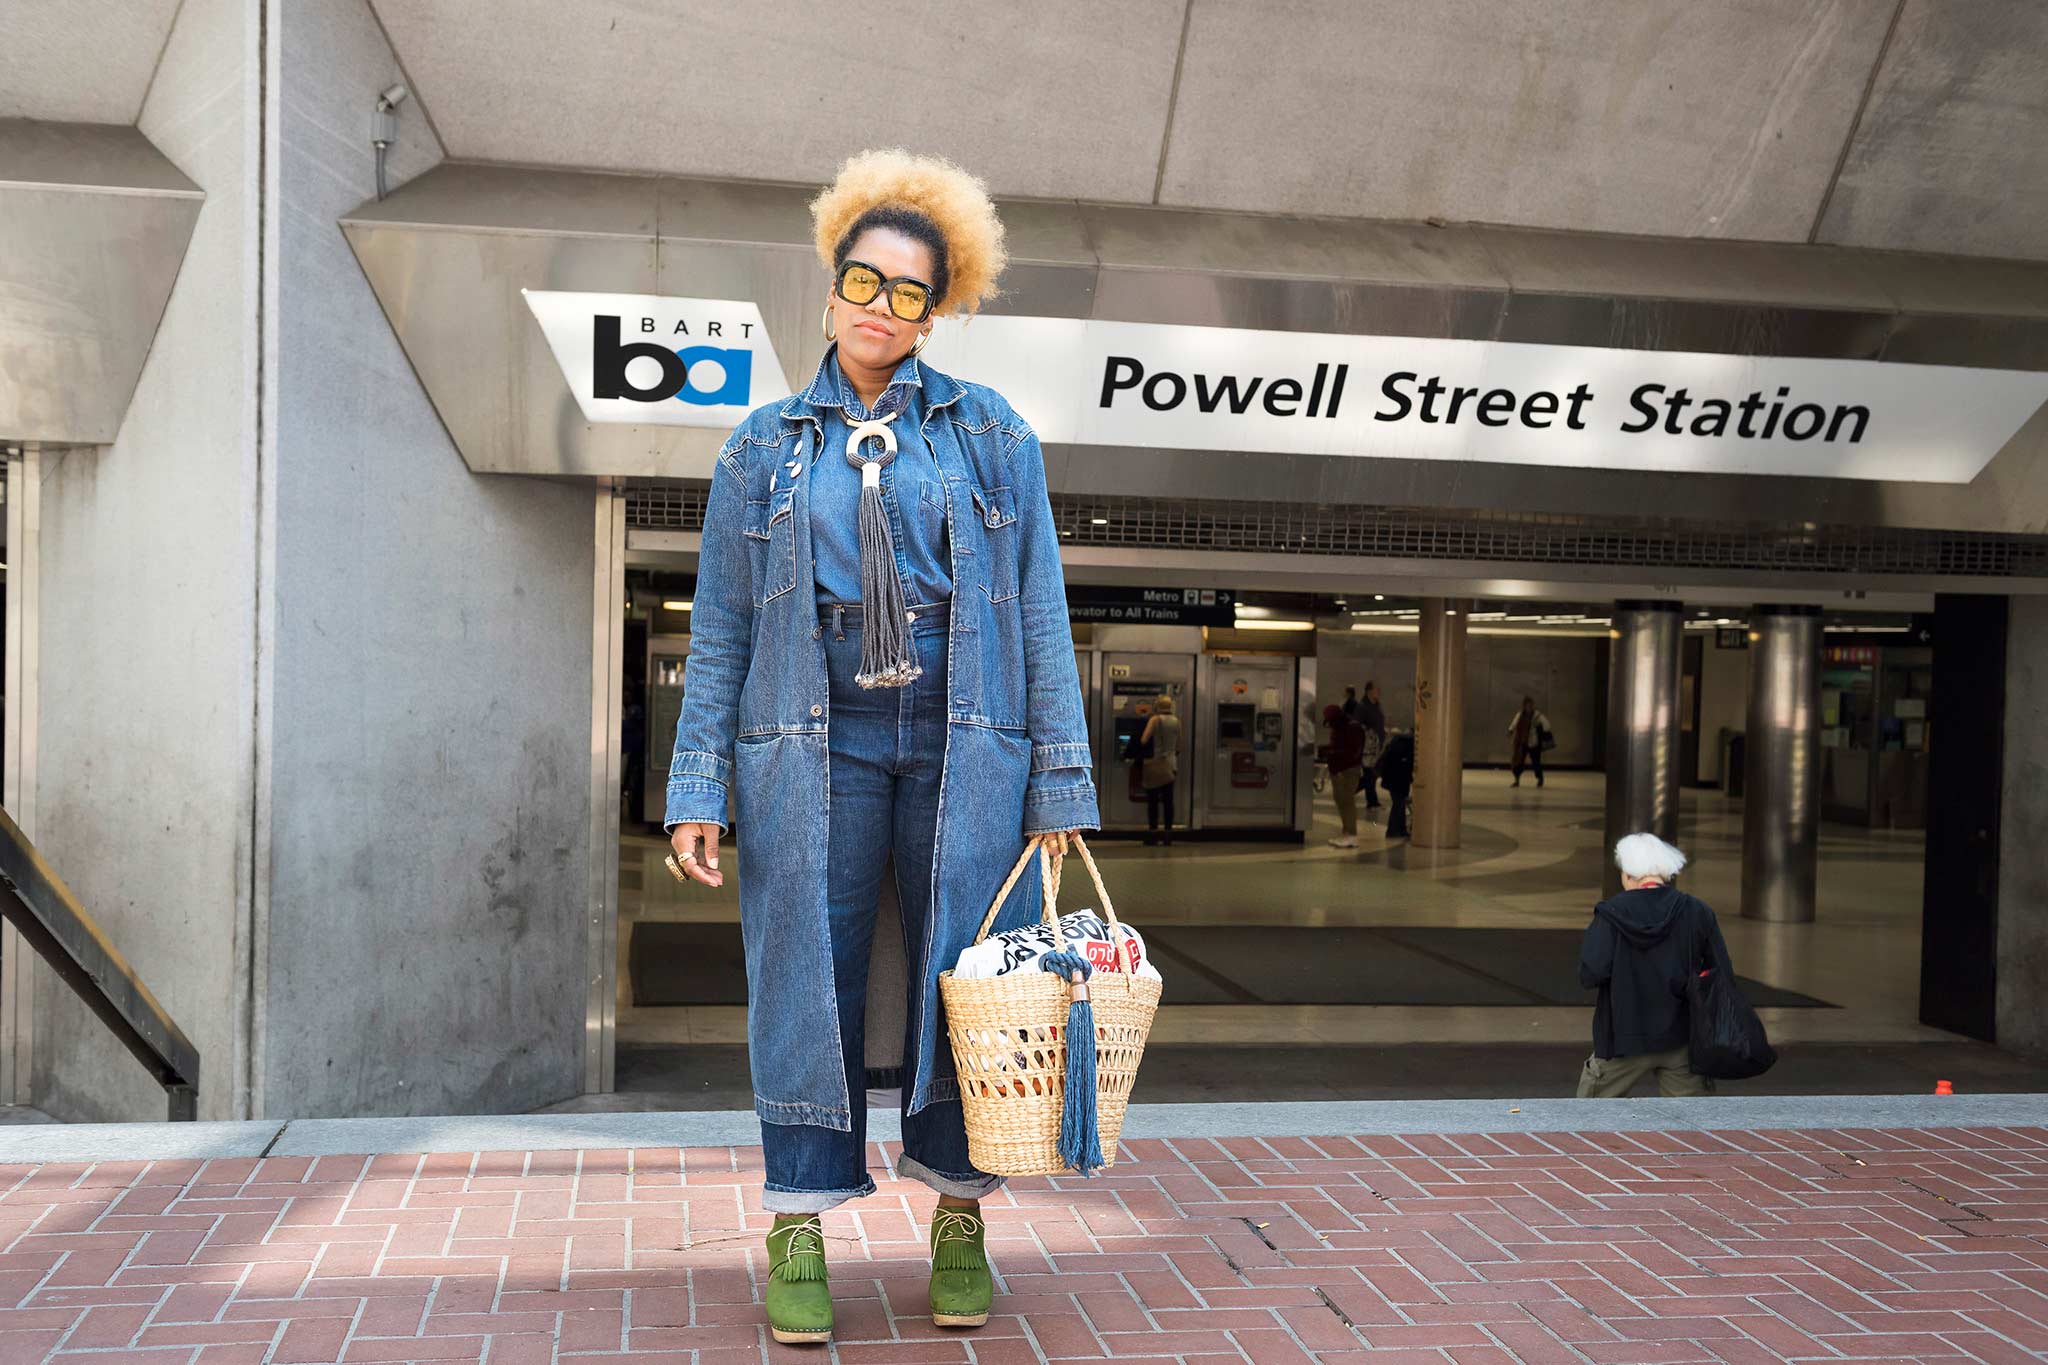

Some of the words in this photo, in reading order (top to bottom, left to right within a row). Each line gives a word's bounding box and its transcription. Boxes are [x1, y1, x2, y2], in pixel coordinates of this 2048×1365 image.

[641, 316, 754, 340] BART
[1099, 355, 1349, 419] Powell
[1373, 371, 1595, 431] Street
[1619, 383, 1871, 444] Station
[1143, 590, 1180, 602] Metro
[1069, 606, 1107, 617] evator
[1110, 606, 1122, 617] to
[1125, 607, 1141, 618] All
[1144, 607, 1180, 619] Trains
